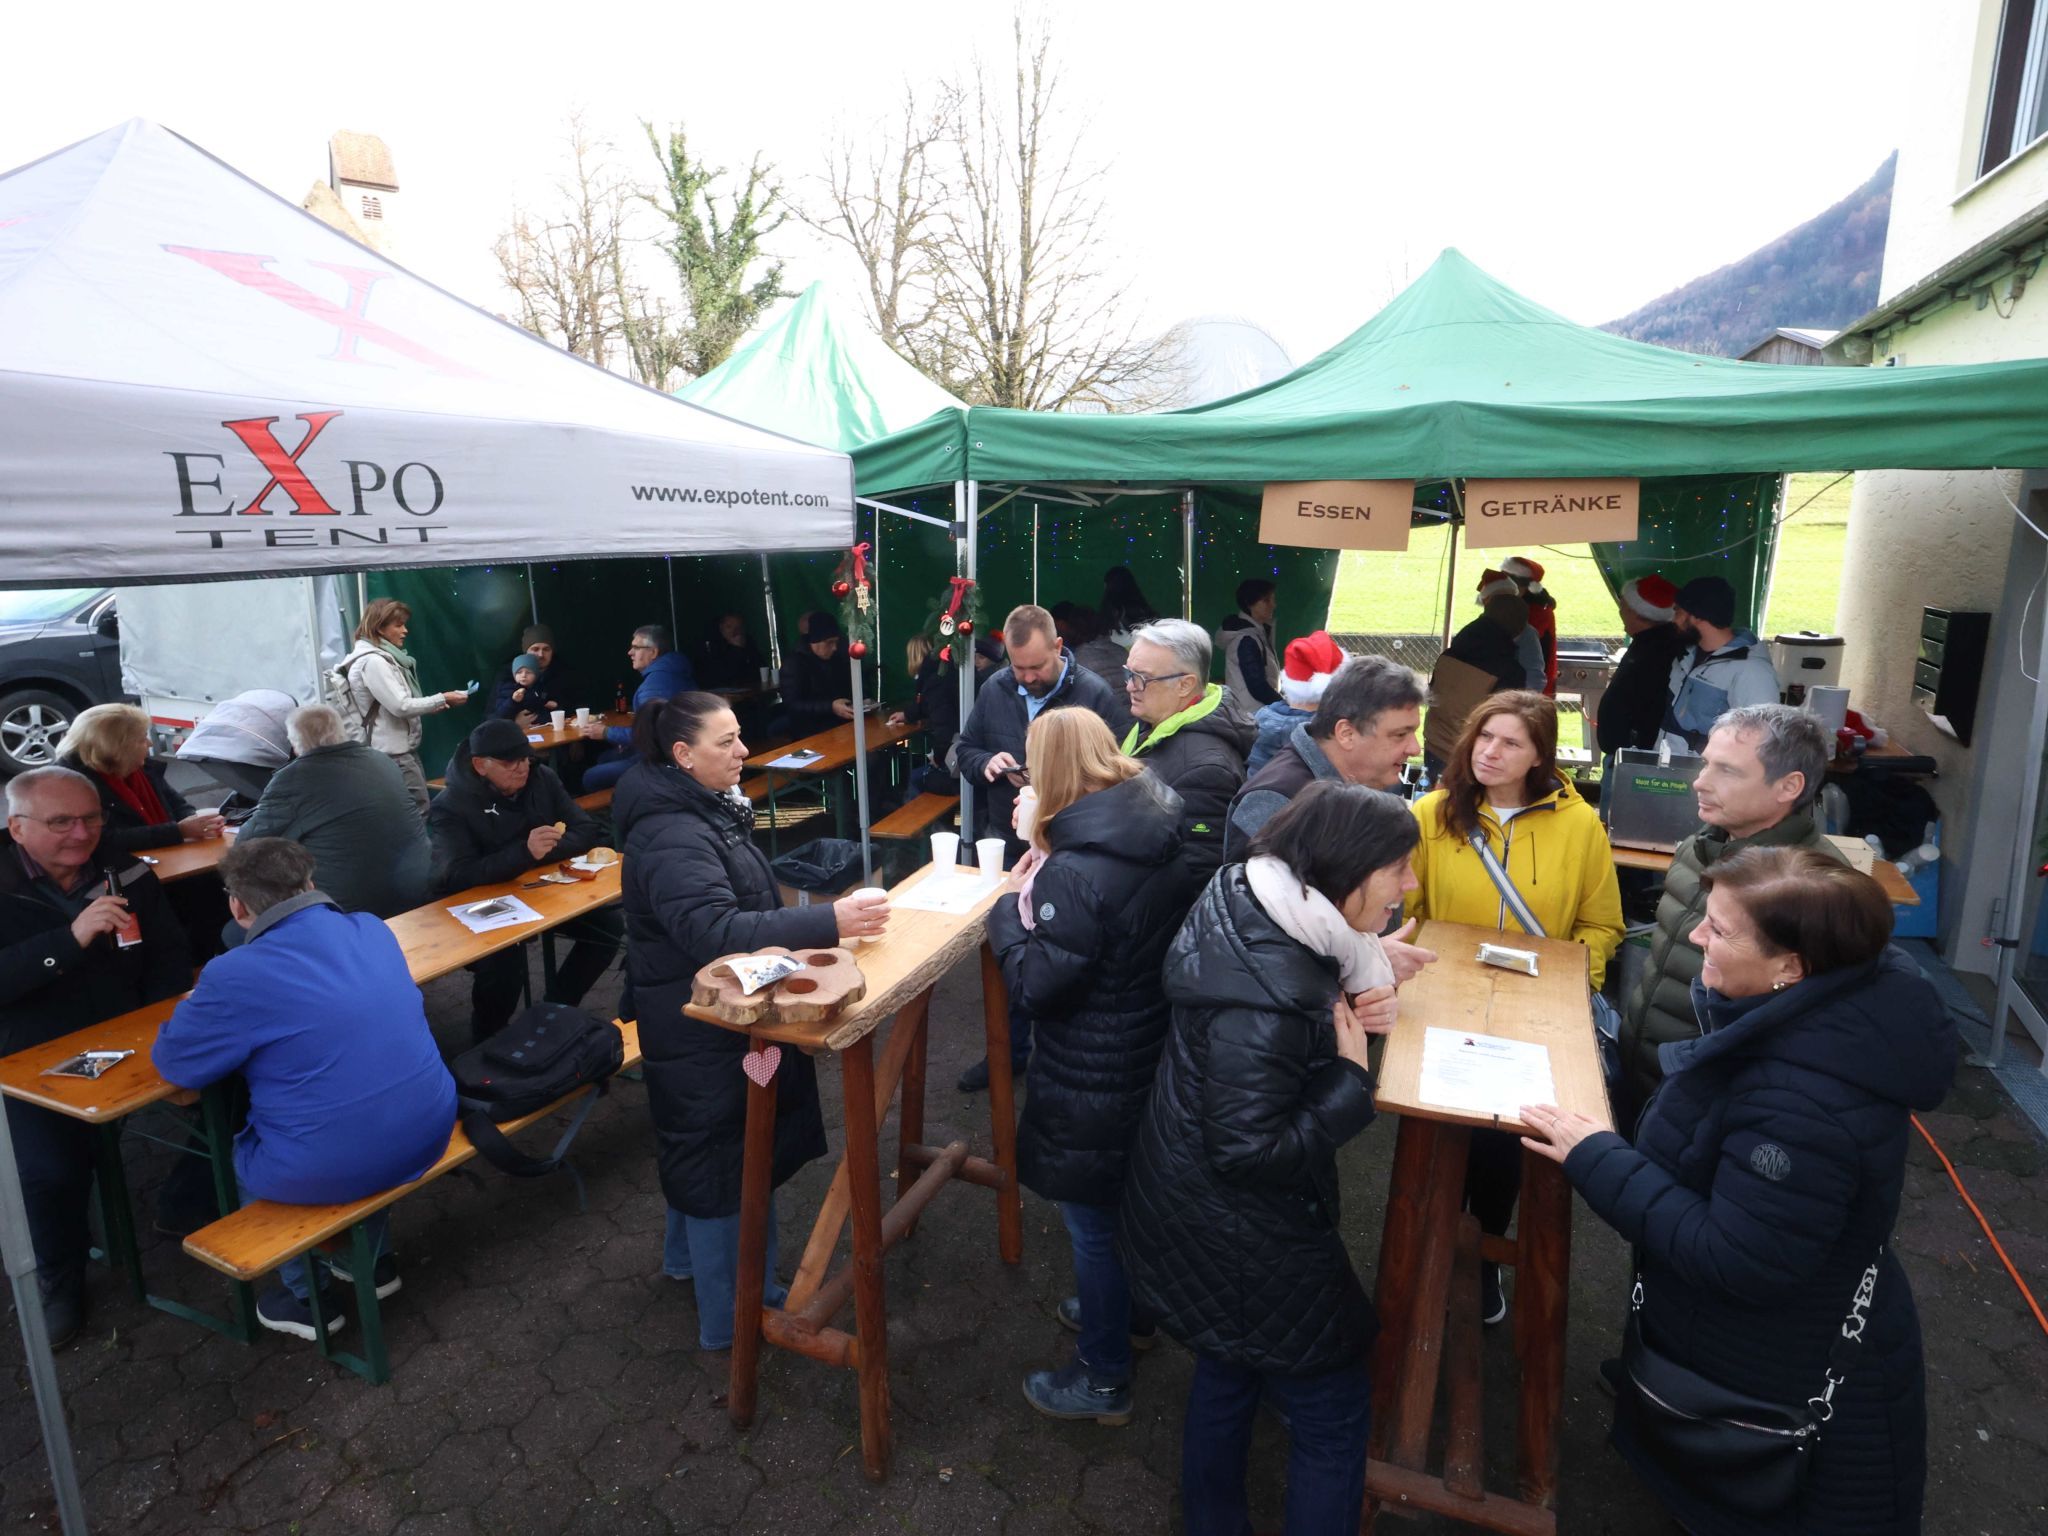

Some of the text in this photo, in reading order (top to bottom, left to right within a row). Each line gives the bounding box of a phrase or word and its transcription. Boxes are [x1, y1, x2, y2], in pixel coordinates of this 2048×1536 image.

[162, 409, 444, 516] EXPO
[631, 485, 829, 508] www.expotent.com
[1480, 494, 1622, 518] GETRÄNKE
[1297, 500, 1372, 521] ESSEN
[175, 526, 448, 549] TENT
